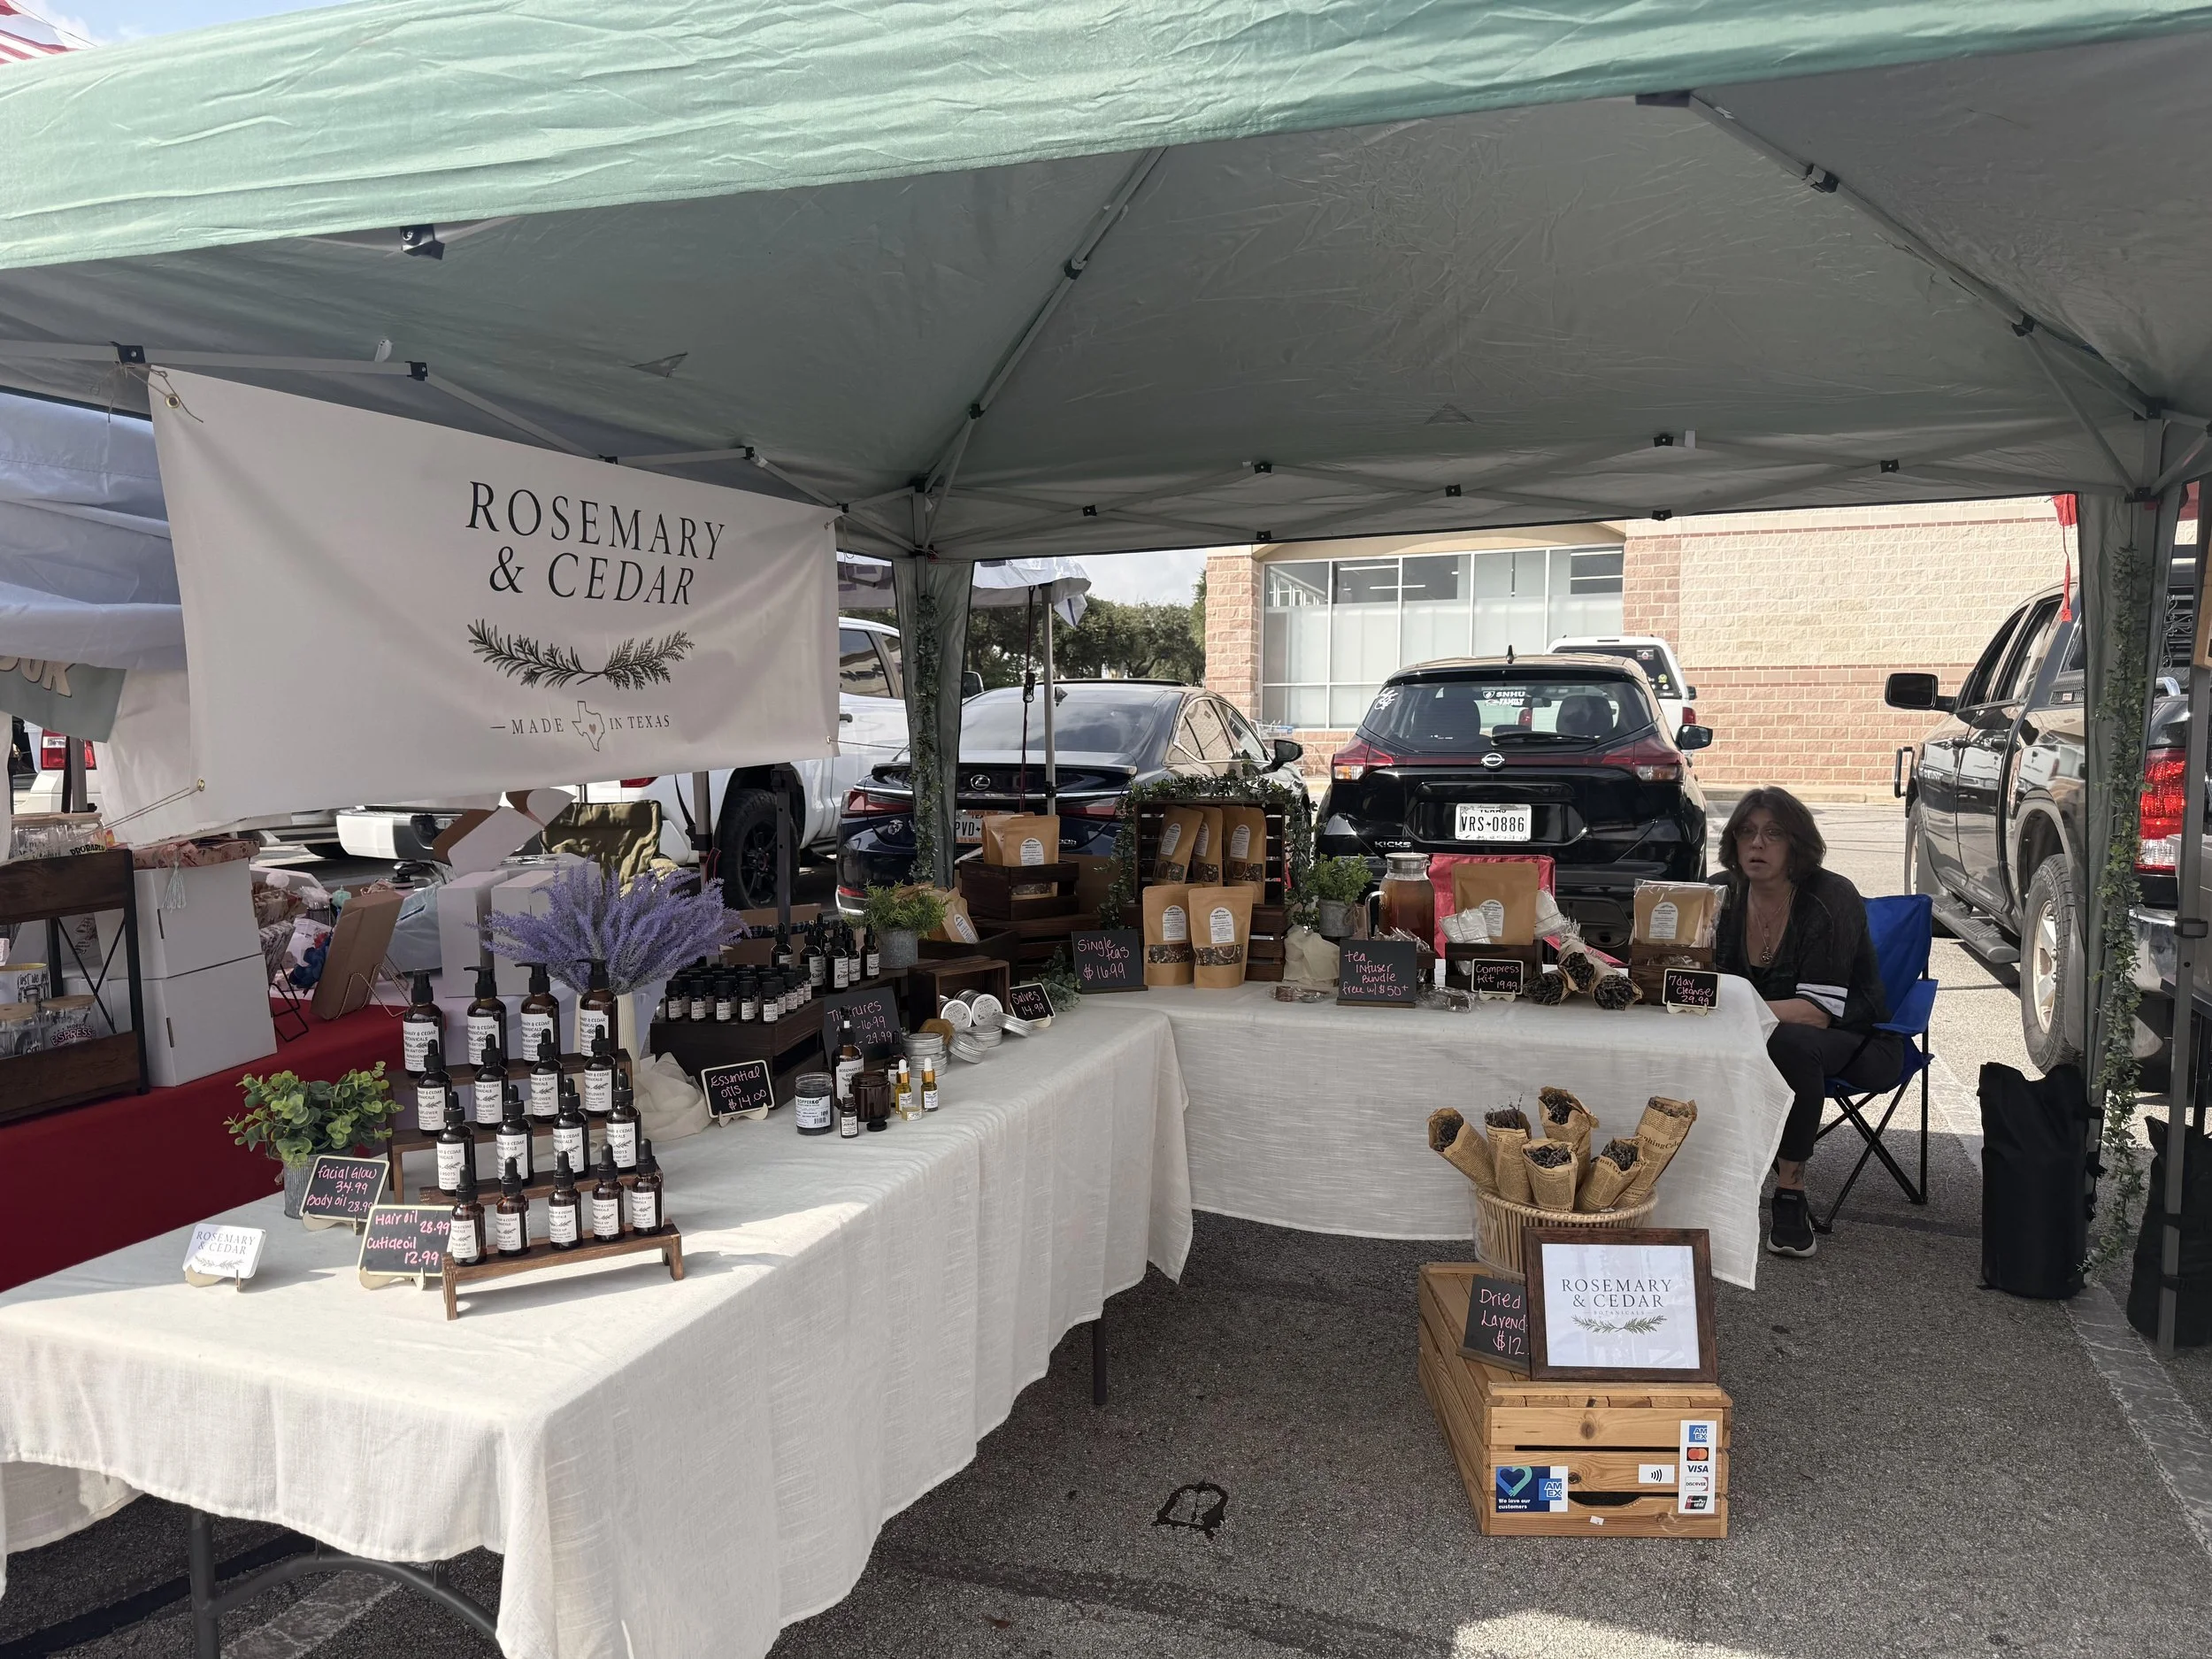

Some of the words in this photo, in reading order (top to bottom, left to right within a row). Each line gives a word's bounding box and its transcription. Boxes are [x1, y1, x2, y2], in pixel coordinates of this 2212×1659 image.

[465, 480, 725, 561] ROSEMARY
[488, 545, 526, 594] &
[548, 552, 695, 605] CEDAR
[512, 718, 564, 735] MADE
[609, 718, 624, 730] IN
[628, 715, 671, 730] TEXAS
[1078, 936, 1116, 957] Single
[1344, 949, 1366, 963] tea
[1082, 962, 1126, 980] $16.99
[1475, 964, 1520, 975] Compress
[1496, 979, 1517, 990] 19.99
[1011, 991, 1041, 1005] Salves
[1681, 995, 1709, 1005] 29.99
[1021, 1002, 1046, 1016] 14.99
[720, 1085, 741, 1098] oils
[728, 1089, 766, 1110] $14.00
[318, 1164, 349, 1180] facial
[350, 1167, 377, 1180] Glow
[335, 1180, 369, 1194] 34.99
[306, 1194, 334, 1210] Body
[334, 1194, 346, 1207] oil
[375, 1214, 401, 1225] Hair
[403, 1210, 419, 1224] oil
[420, 1221, 450, 1235] 28.99
[196, 1231, 256, 1246] ROSEMARY
[209, 1242, 247, 1256] CEDAR
[404, 1251, 439, 1266] 12.99
[1561, 1279, 1671, 1292] ROSEMARY
[1479, 1288, 1521, 1310] Dried
[1572, 1294, 1586, 1308] &
[1594, 1294, 1664, 1308] CEDAR
[1481, 1310, 1528, 1333] Lavend
[1686, 1464, 1709, 1473] VISA
